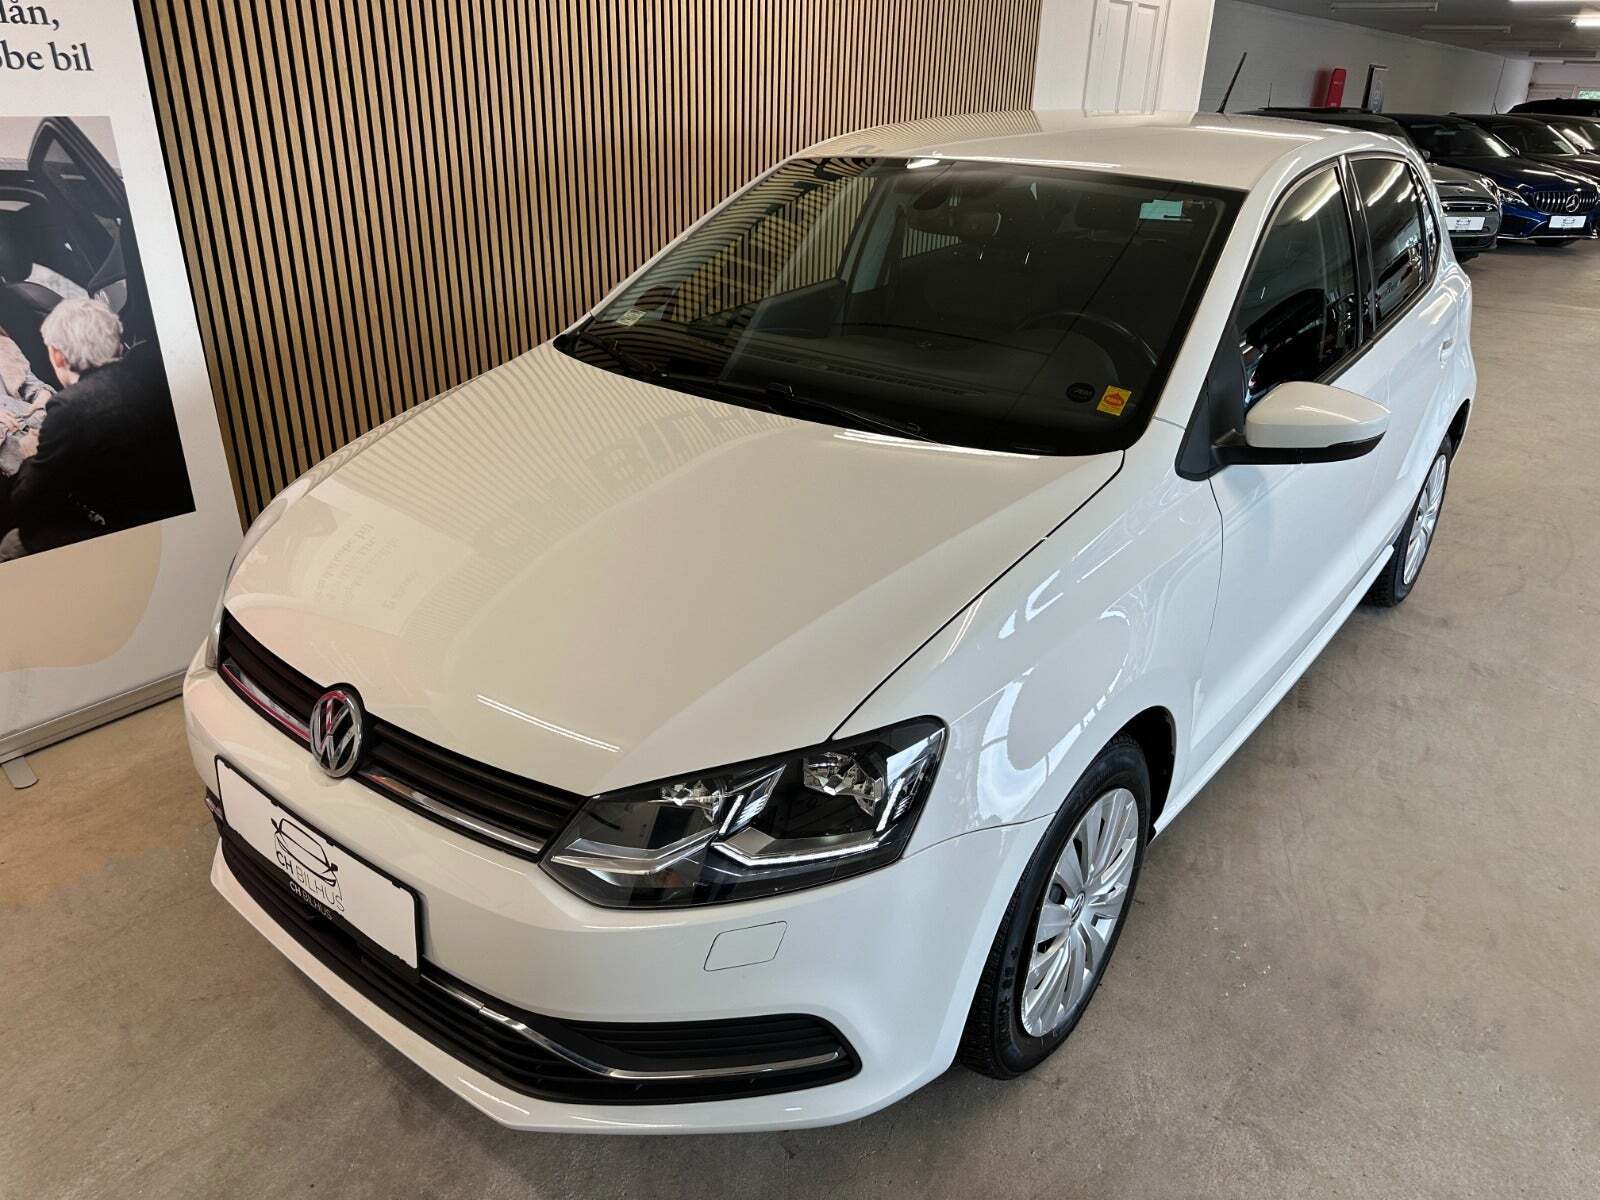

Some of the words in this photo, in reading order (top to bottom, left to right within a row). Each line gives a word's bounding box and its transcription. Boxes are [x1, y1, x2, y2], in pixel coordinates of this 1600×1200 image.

[0, 39, 44, 70] be
[47, 41, 94, 71] bil
[276, 851, 294, 874] CH
[295, 865, 345, 912] BILHUS
[289, 881, 302, 897] CH
